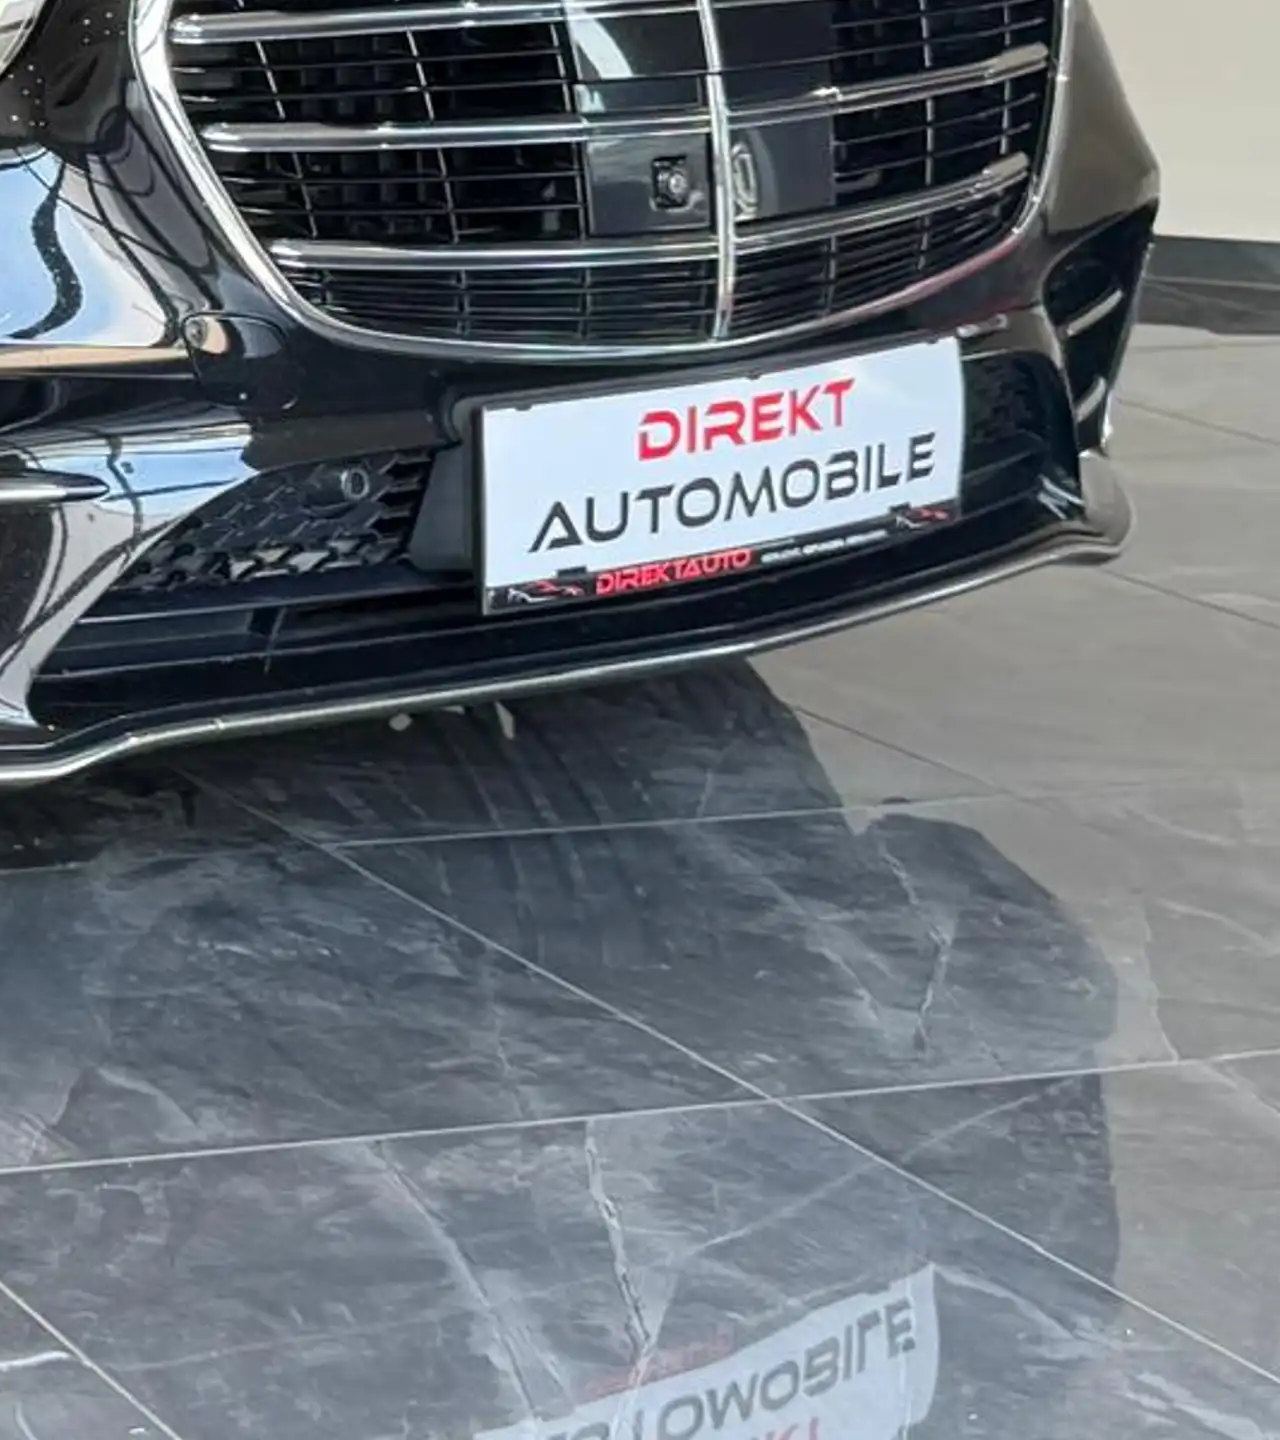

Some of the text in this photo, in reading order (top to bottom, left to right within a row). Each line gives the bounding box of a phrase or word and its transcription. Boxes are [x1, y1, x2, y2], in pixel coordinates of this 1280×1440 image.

[637, 378, 855, 461] DIREKT
[528, 432, 936, 553] AUTOMOBILE
[595, 548, 753, 595] DIREKTAUTO
